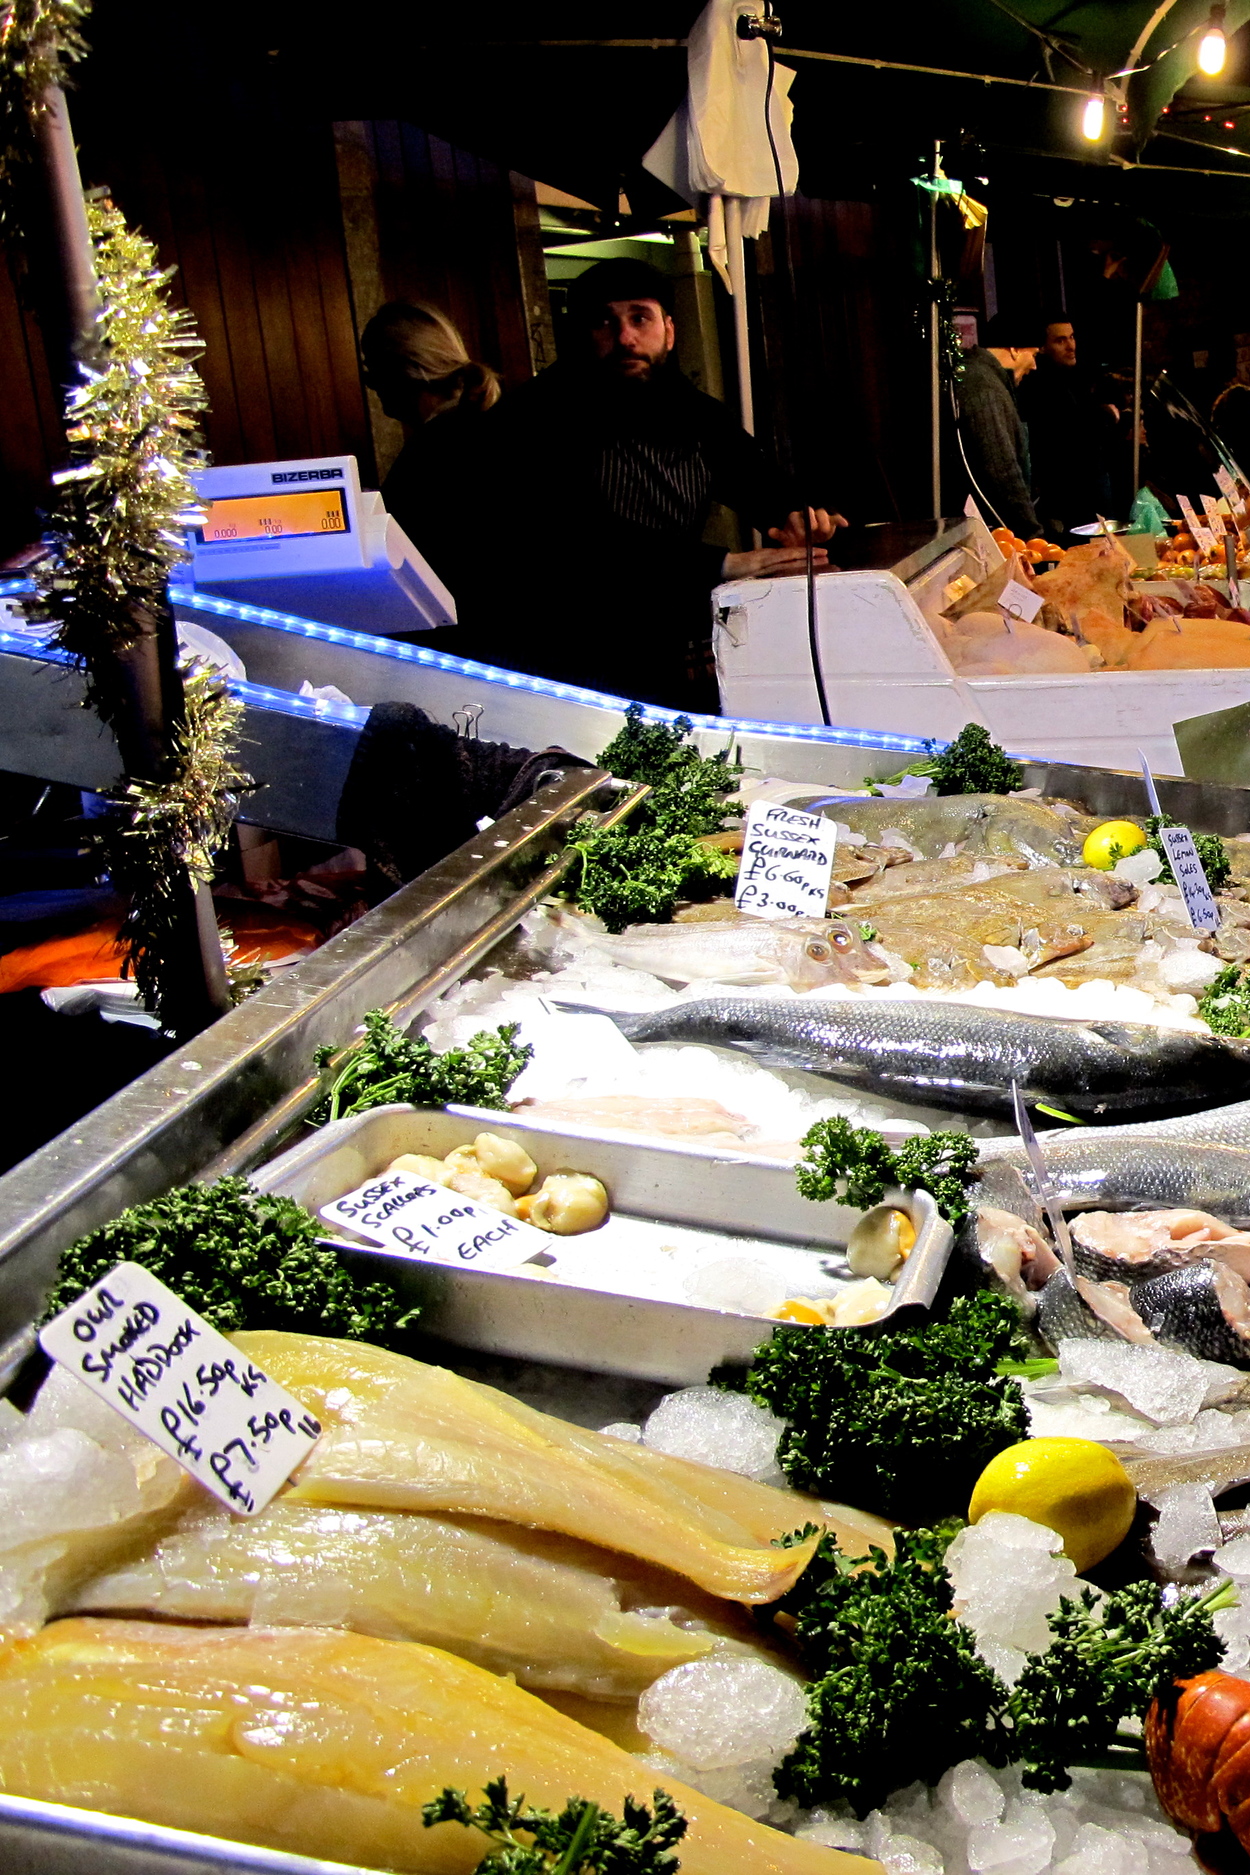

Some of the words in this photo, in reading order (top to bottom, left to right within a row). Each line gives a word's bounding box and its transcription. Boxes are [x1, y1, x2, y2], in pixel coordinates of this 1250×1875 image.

[272, 469, 343, 483] BIZERBA
[321, 517, 341, 530] 0.00
[766, 808, 821, 830] FRESH
[750, 823, 820, 846] SUSSEX
[1172, 848, 1194, 862] LEMON
[336, 1176, 405, 1218] SUSSEX
[457, 1218, 519, 1260] EACH
